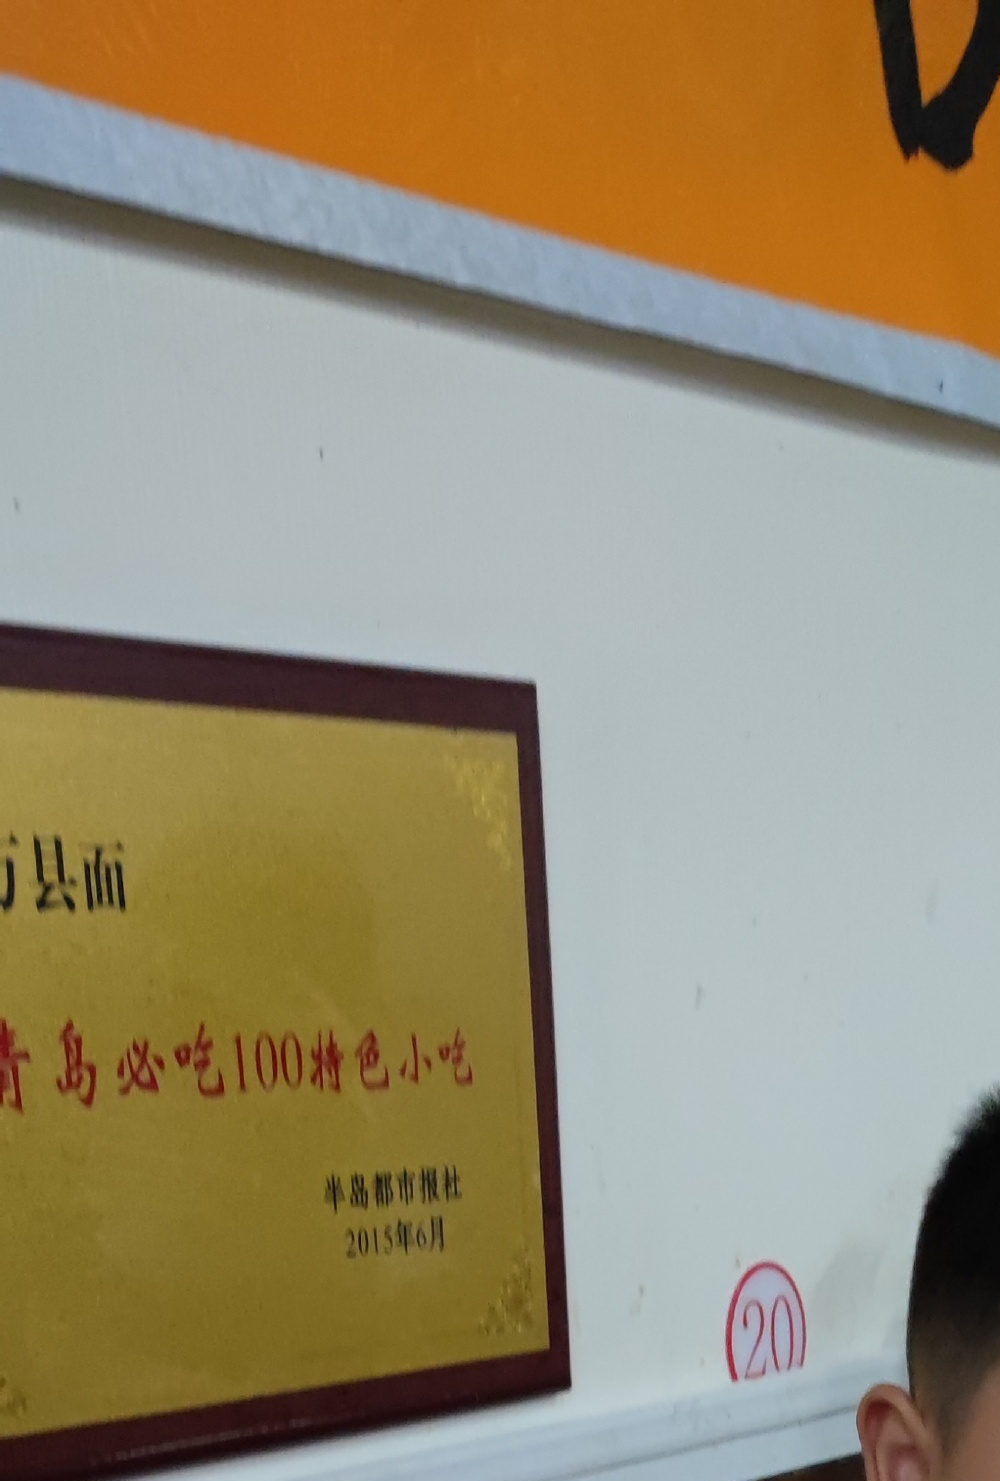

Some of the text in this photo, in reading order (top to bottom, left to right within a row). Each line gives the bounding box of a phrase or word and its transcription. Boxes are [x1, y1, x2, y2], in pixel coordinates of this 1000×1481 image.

[325, 1164, 462, 1214] 半岛都市报社
[346, 1215, 444, 1258] 2015年6月
[742, 1294, 794, 1379] 20
